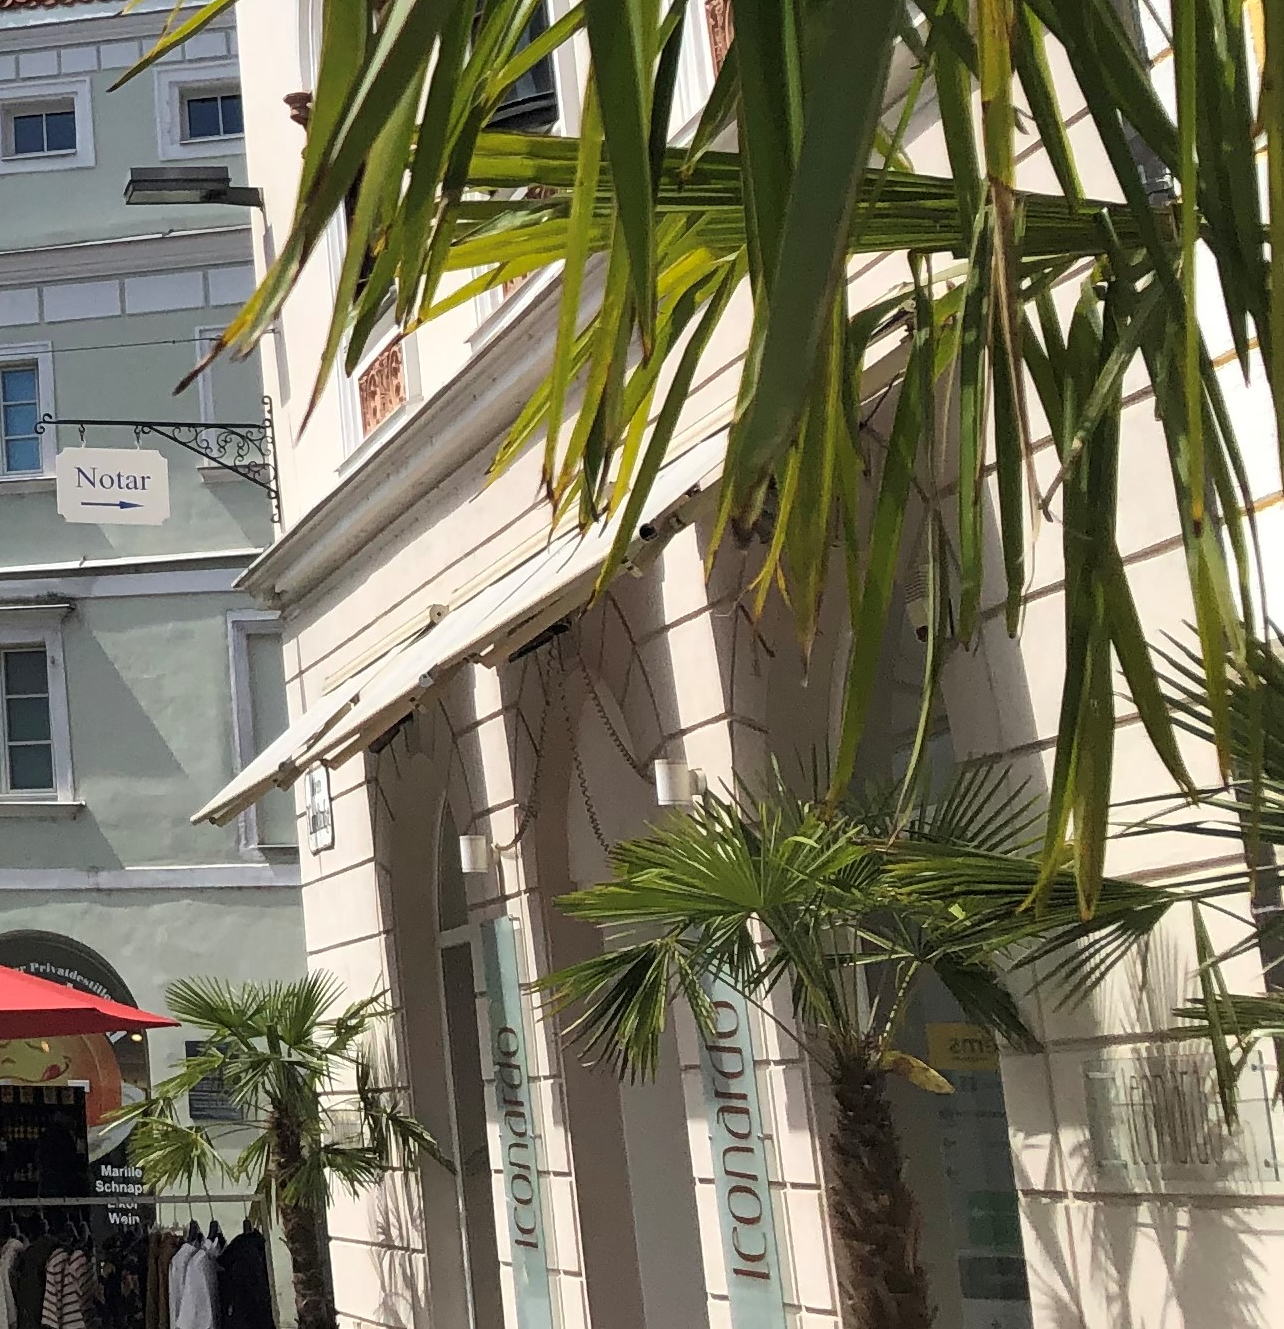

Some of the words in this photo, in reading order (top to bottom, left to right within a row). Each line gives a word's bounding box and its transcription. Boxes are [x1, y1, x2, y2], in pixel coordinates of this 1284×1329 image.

[75, 466, 151, 492] Notar
[100, 1164, 142, 1178] Marille
[95, 1180, 143, 1195] Schnap
[108, 1212, 140, 1225] Wein
